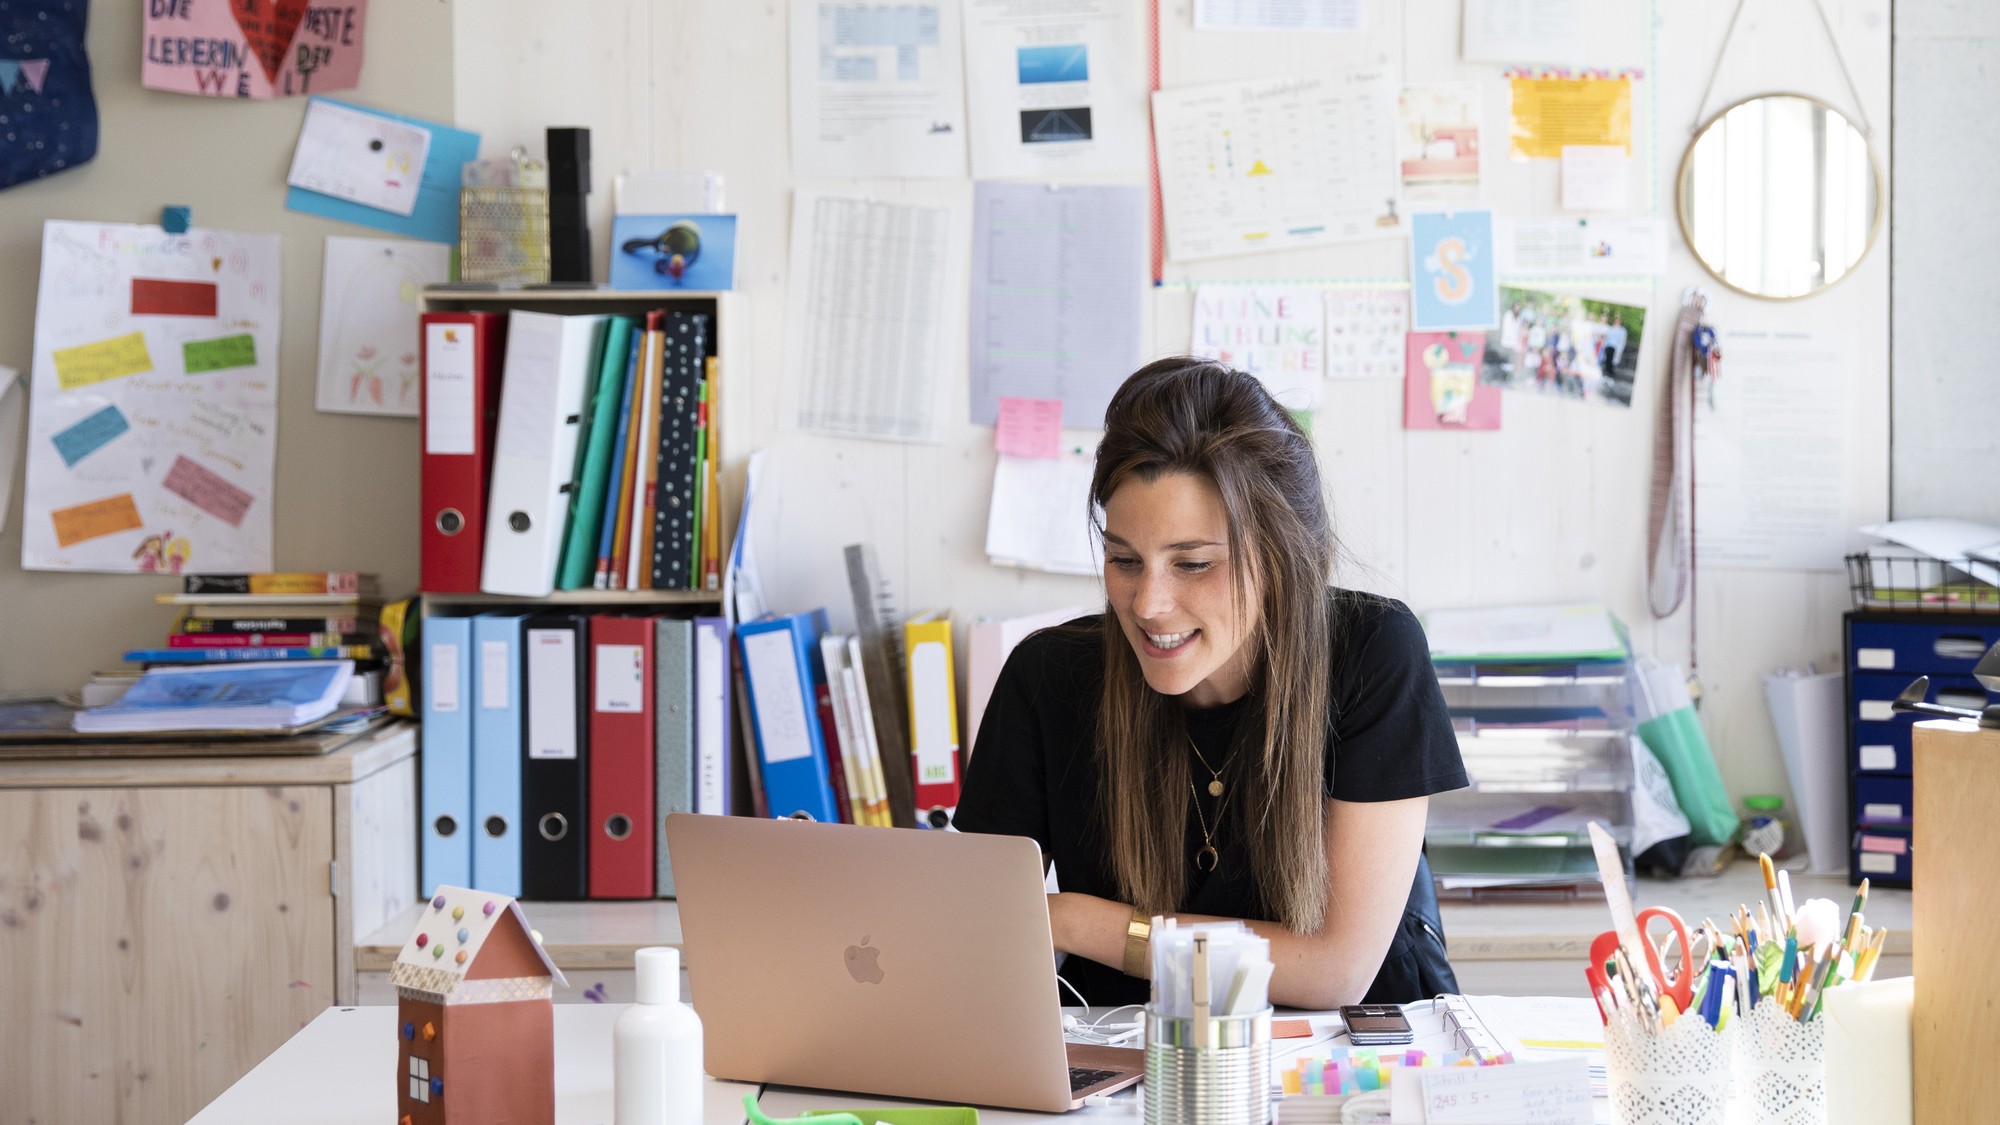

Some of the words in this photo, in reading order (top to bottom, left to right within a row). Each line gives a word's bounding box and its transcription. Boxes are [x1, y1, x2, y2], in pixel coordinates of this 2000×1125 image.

[150, 0, 192, 19] DIE
[297, 44, 331, 71] DER
[1435, 239, 1470, 300] S
[1193, 938, 1207, 954] T
